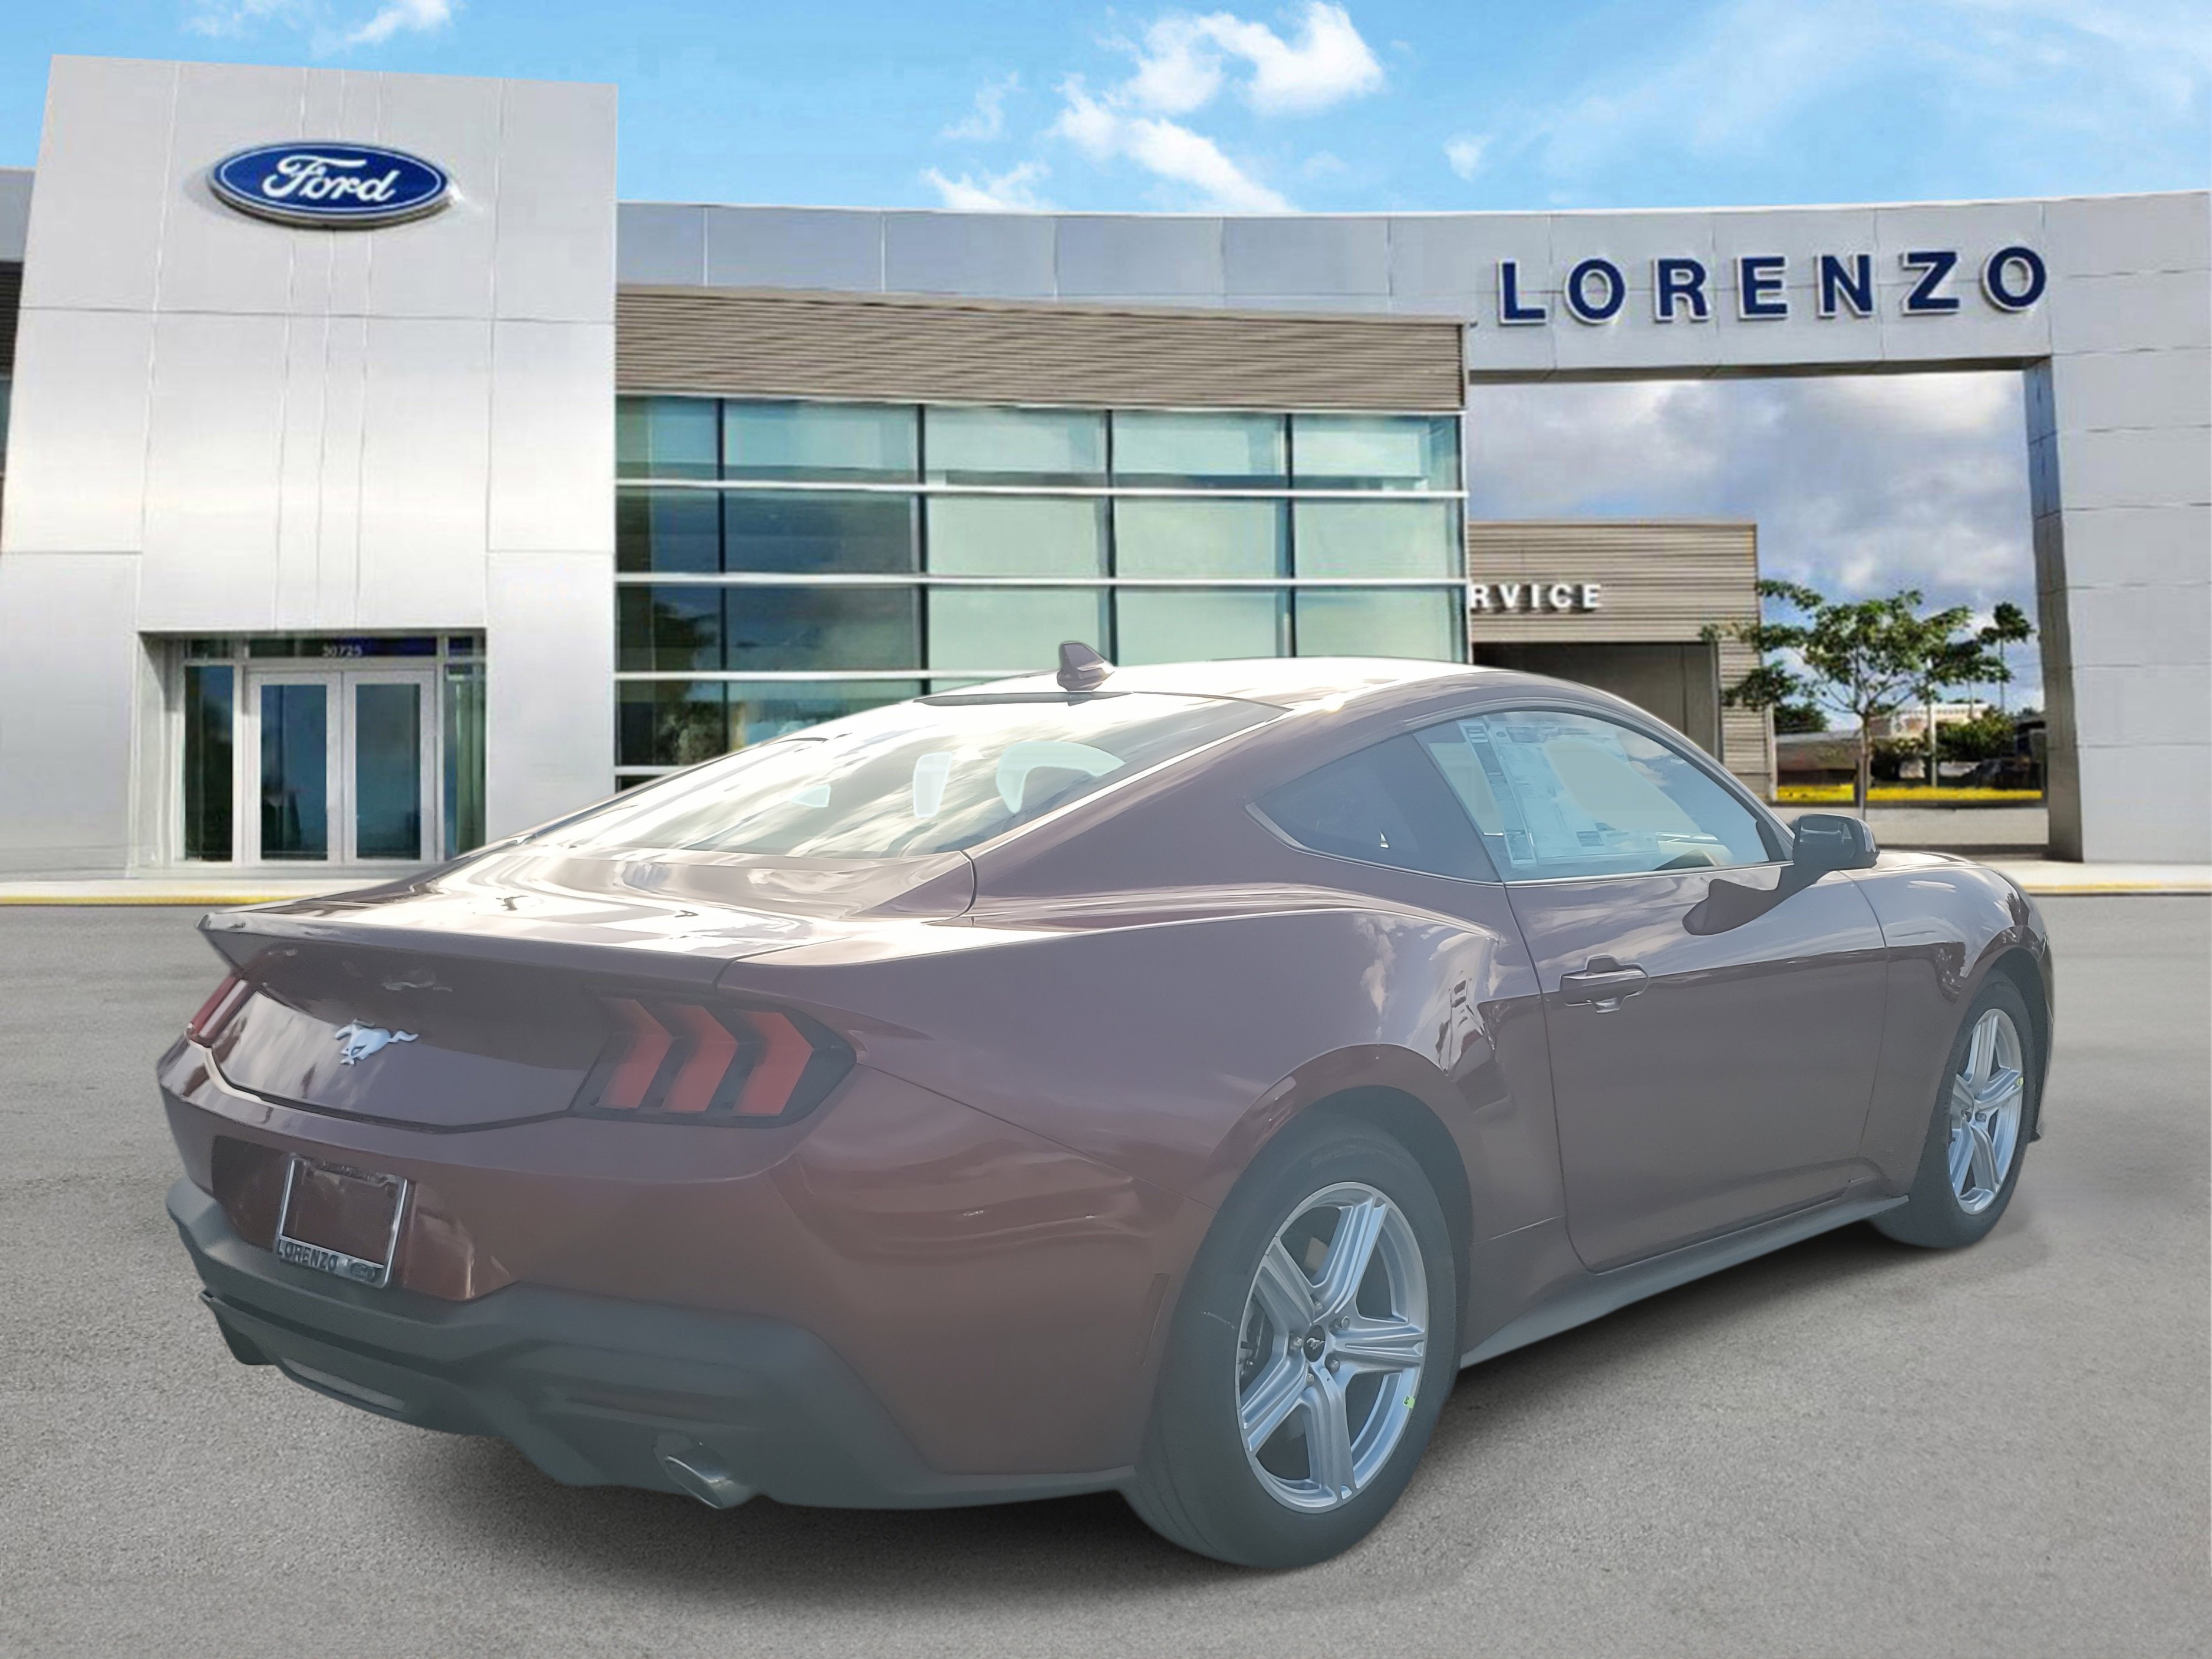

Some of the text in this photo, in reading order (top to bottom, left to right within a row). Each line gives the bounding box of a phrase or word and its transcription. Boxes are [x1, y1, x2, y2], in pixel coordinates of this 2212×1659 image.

[262, 154, 401, 202] Ford
[1497, 246, 2048, 325] LORENZO
[278, 1239, 339, 1271] LORENZO
